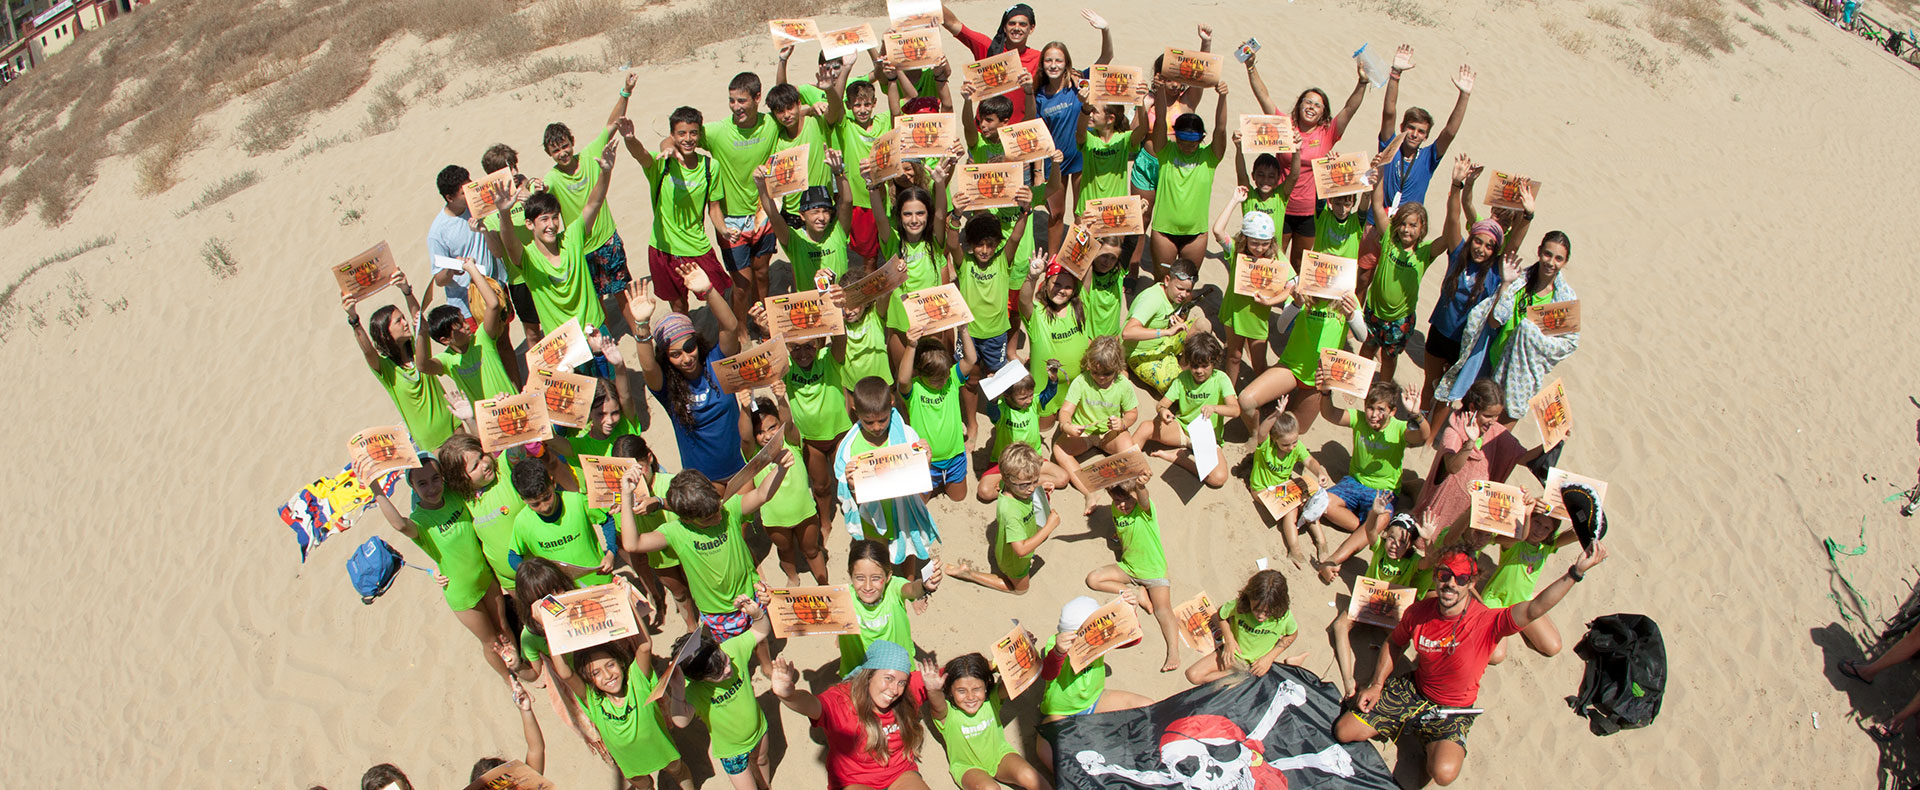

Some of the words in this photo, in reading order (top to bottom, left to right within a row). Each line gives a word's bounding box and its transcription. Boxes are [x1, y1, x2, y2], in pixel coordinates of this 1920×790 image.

[898, 36, 929, 46] DIPLOMA
[977, 60, 1009, 74] DIPLOMA
[1177, 56, 1210, 68] DIPLOMA
[1102, 72, 1133, 80] DIPLOMA
[908, 121, 942, 130] DIPLOMA
[1011, 127, 1038, 140] DIPLOMA
[1326, 161, 1357, 171] DIPLOMA
[974, 172, 1009, 181] DIPLOMA
[1098, 204, 1129, 212] DIPLOMA
[349, 256, 380, 278] DIPLOMA
[1248, 263, 1278, 275] DIPLOMA
[1313, 260, 1343, 272] DIPLOMA
[784, 299, 824, 311] DIPLOMA
[917, 292, 949, 306] DIPLOMA
[1051, 325, 1079, 340] Kanela
[538, 331, 568, 355] DIPLOMA
[732, 350, 772, 370] DIPLOMA
[1330, 356, 1361, 371] DIPLOMA
[544, 378, 581, 393] DIPLOMA
[491, 403, 530, 417] DIPLOMA
[359, 433, 396, 449] DIPLOMA
[869, 452, 910, 467] DIPLOMA
[1092, 457, 1129, 474] DIPLOMA
[1485, 490, 1515, 503] DIPLOMA
[438, 510, 461, 534] Kanela
[538, 534, 574, 548] Kanela
[693, 533, 728, 551] Kanela
[785, 595, 832, 604] DIPLOMA
[1368, 587, 1401, 600] DIPLOMA
[566, 619, 615, 638] DIPLOMA
[1078, 612, 1117, 638] DIPLOMA
[1238, 619, 1270, 635] Kanela
[711, 678, 743, 705] Kanela
